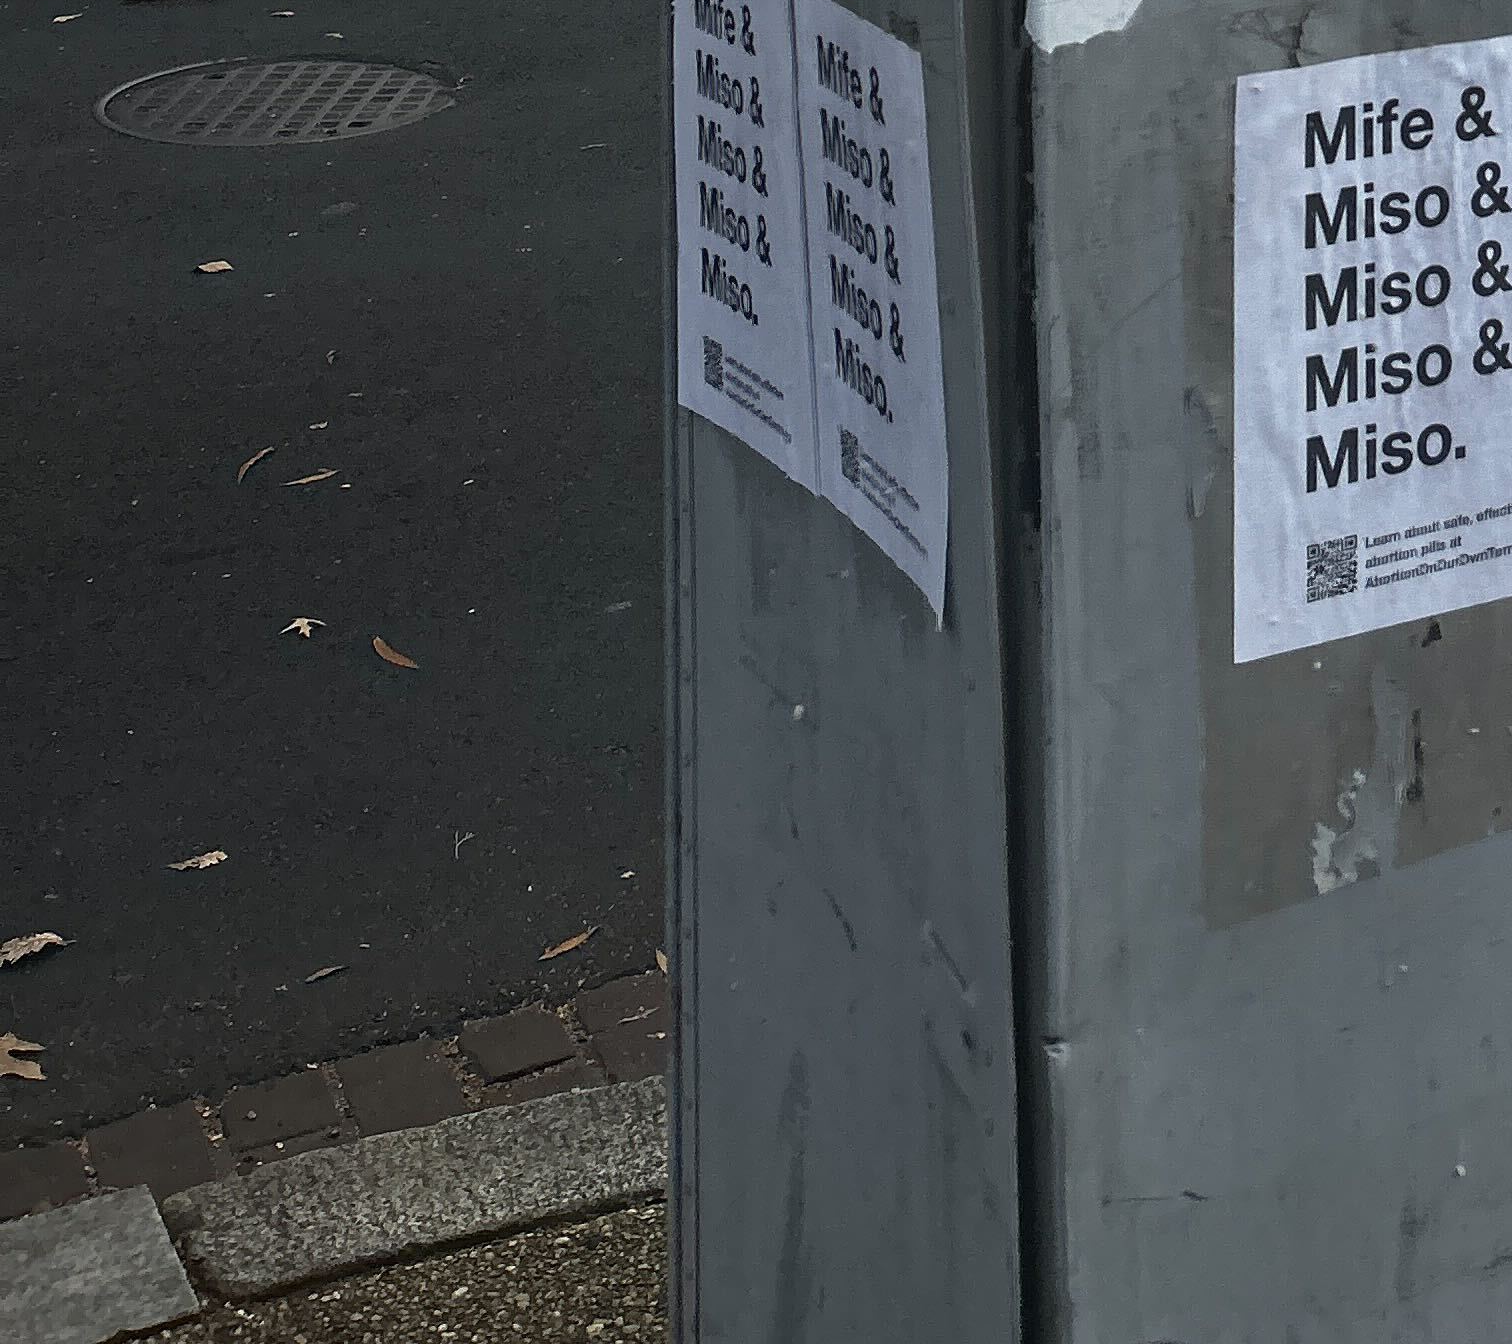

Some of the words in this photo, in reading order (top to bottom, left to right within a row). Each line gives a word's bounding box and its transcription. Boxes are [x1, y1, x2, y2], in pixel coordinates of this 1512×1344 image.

[739, 4, 757, 58] &
[695, 48, 745, 117] Miso
[748, 76, 766, 130] &
[815, 34, 864, 114] Mife
[868, 66, 887, 129] &
[696, 114, 747, 185] Miso
[751, 144, 769, 200] &
[818, 107, 873, 192] Miso
[875, 147, 897, 209] &
[1304, 98, 1434, 169] Mife
[1455, 85, 1497, 142] &
[697, 181, 750, 252] Miso
[755, 214, 773, 269] &
[823, 180, 879, 266] Miso
[883, 224, 902, 288] &
[1304, 181, 1450, 250] Miso
[1470, 161, 1512, 219] &
[700, 247, 760, 327] Miso.
[828, 254, 884, 343] Miso
[888, 298, 907, 365] &
[1305, 262, 1451, 331] Miso
[832, 327, 895, 424] Miso.
[1305, 343, 1453, 413] Miso
[1306, 423, 1467, 494] Miso.
[1364, 531, 1400, 548] Learn
[1404, 520, 1441, 539] about
[1443, 514, 1474, 529] safe,
[1364, 546, 1418, 569] abortion
[1420, 539, 1446, 558] pills
[1449, 535, 1463, 549] at
